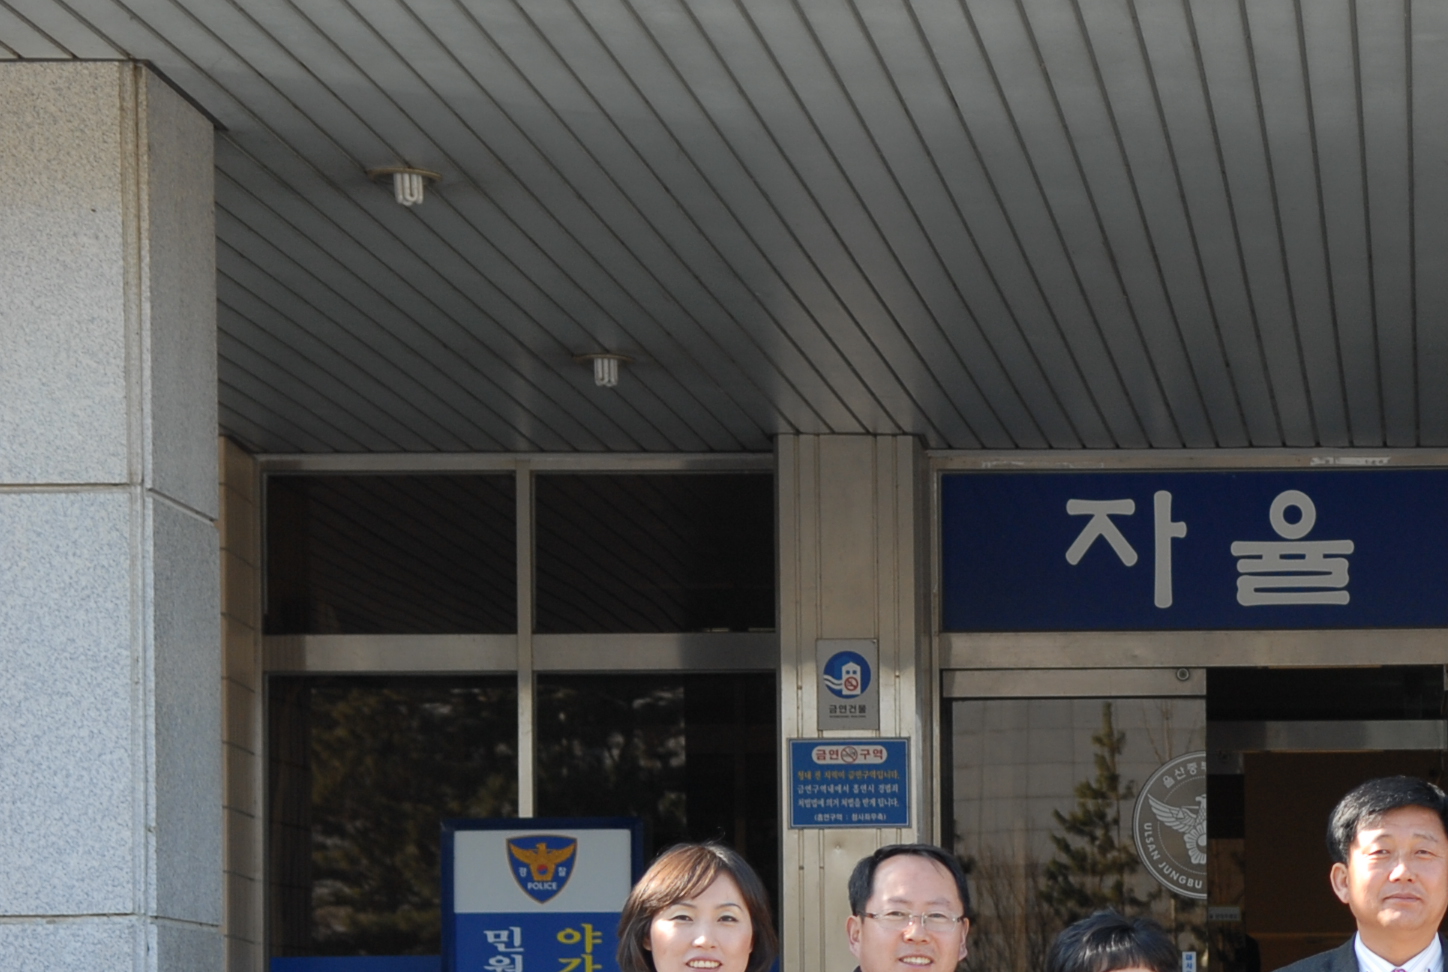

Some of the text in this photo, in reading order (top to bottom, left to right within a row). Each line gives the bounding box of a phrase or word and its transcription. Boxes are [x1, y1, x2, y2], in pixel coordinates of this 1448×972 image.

[1065, 489, 1355, 609] 자율
[829, 704, 867, 714] 금연건물
[816, 748, 884, 761] 금연 구역
[1143, 822, 1203, 889] ULSAN JUNGBU
[527, 882, 558, 890] POLICE
